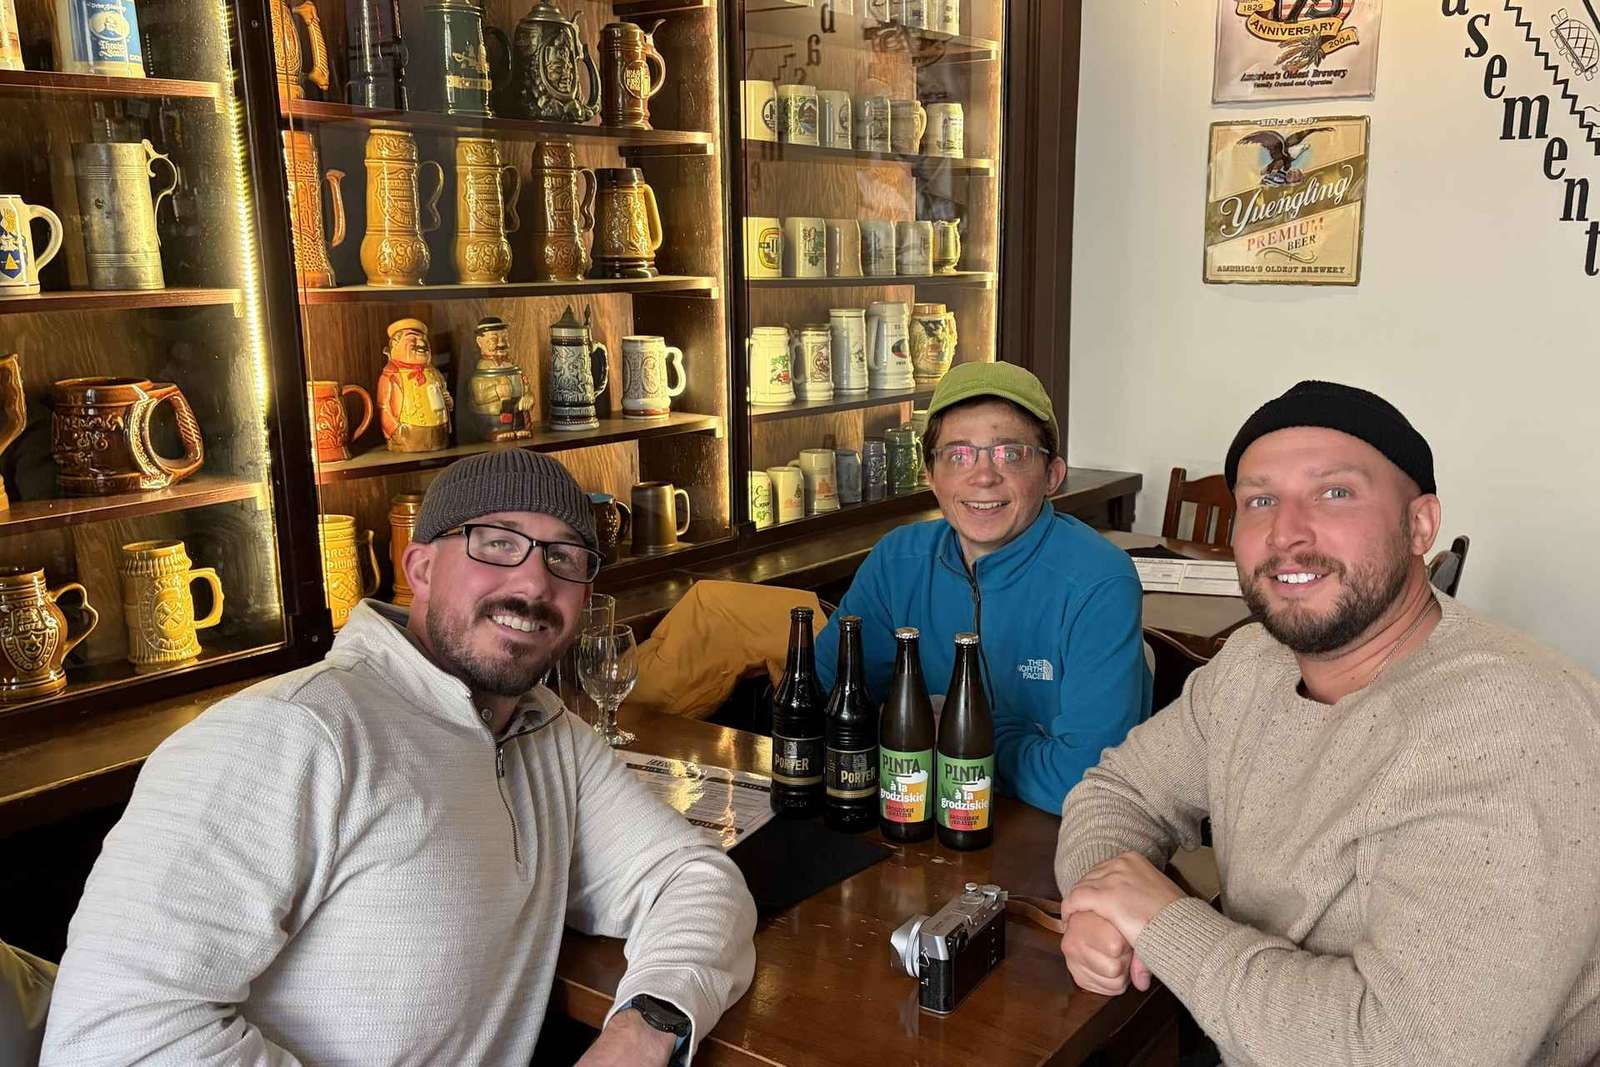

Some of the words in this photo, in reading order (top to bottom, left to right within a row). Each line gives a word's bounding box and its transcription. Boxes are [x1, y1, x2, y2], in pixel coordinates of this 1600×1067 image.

[1243, 4, 1264, 12] 1829
[1250, 19, 1335, 36] ANNIVERSARY
[1328, 35, 1351, 48] 2004
[1220, 165, 1354, 237] Yuengling
[1247, 217, 1325, 251] PREMIUM
[1287, 234, 1317, 251] BEER
[1216, 265, 1263, 273] AMERICA'S
[1265, 265, 1299, 274] OLDEST
[1301, 266, 1346, 274] BREWERY
[1016, 664, 1043, 673] NORTH
[1027, 659, 1043, 667] THE
[774, 753, 810, 771] PORTER
[882, 754, 921, 774] PINTA
[840, 766, 876, 784] PORTER
[944, 763, 987, 782] PINTA
[890, 780, 897, 791] à
[898, 782, 908, 792] la
[954, 789, 962, 799] à
[963, 790, 974, 800] la
